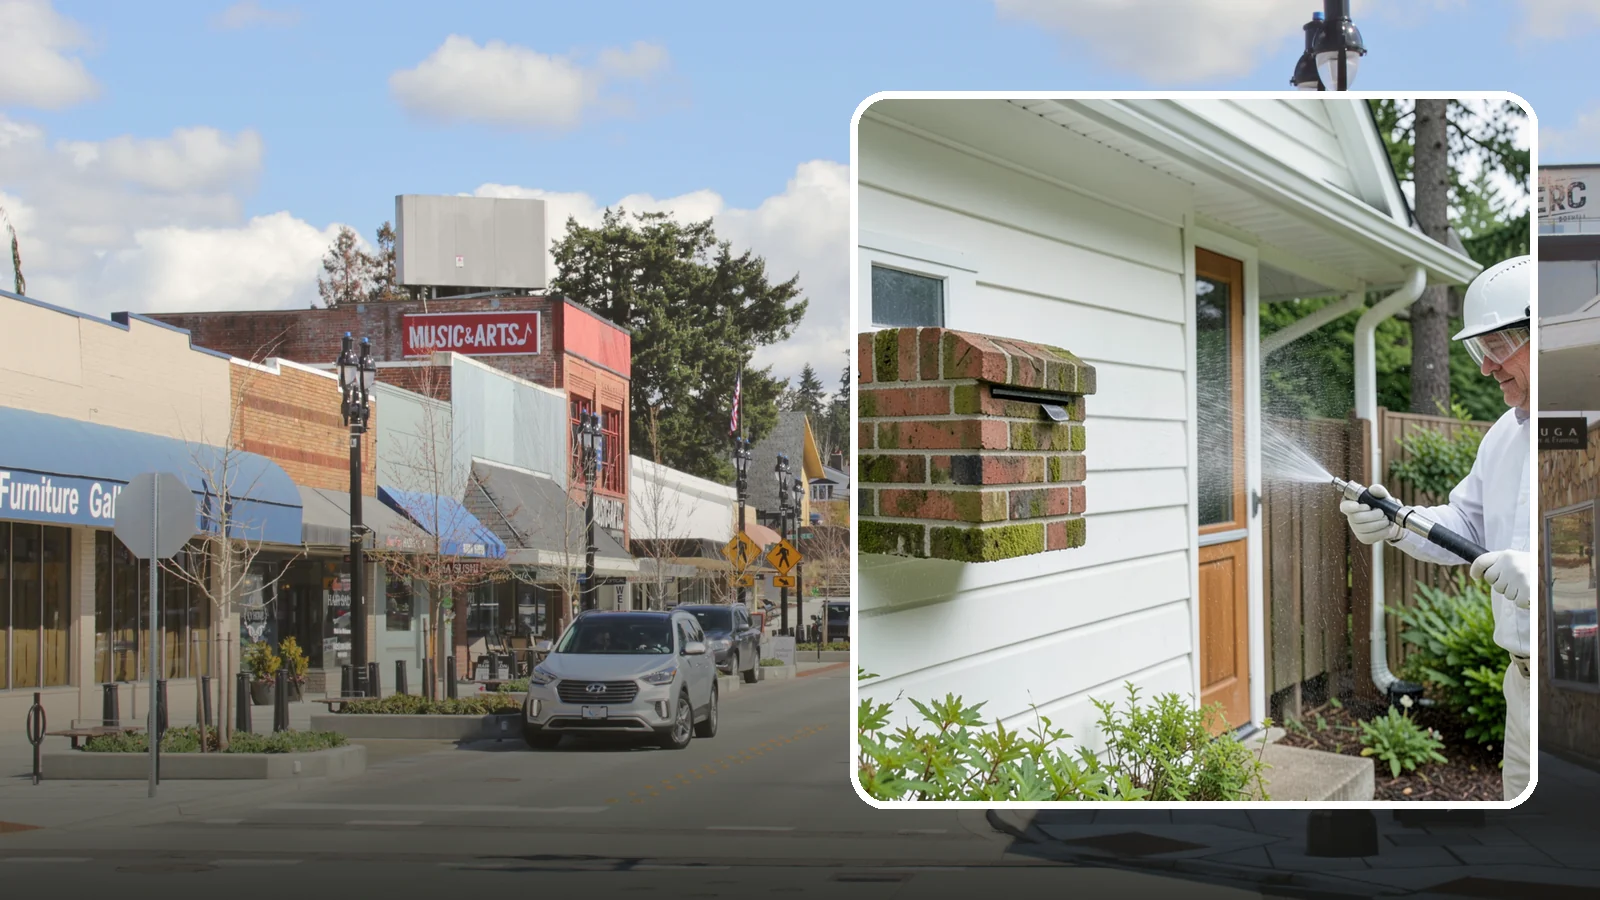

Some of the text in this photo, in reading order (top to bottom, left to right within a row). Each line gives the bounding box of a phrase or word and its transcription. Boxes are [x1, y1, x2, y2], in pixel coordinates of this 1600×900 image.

[409, 323, 520, 348] MUSIC&ARTS
[0, 471, 79, 515] Furniture
[453, 563, 480, 574] SUSHI
